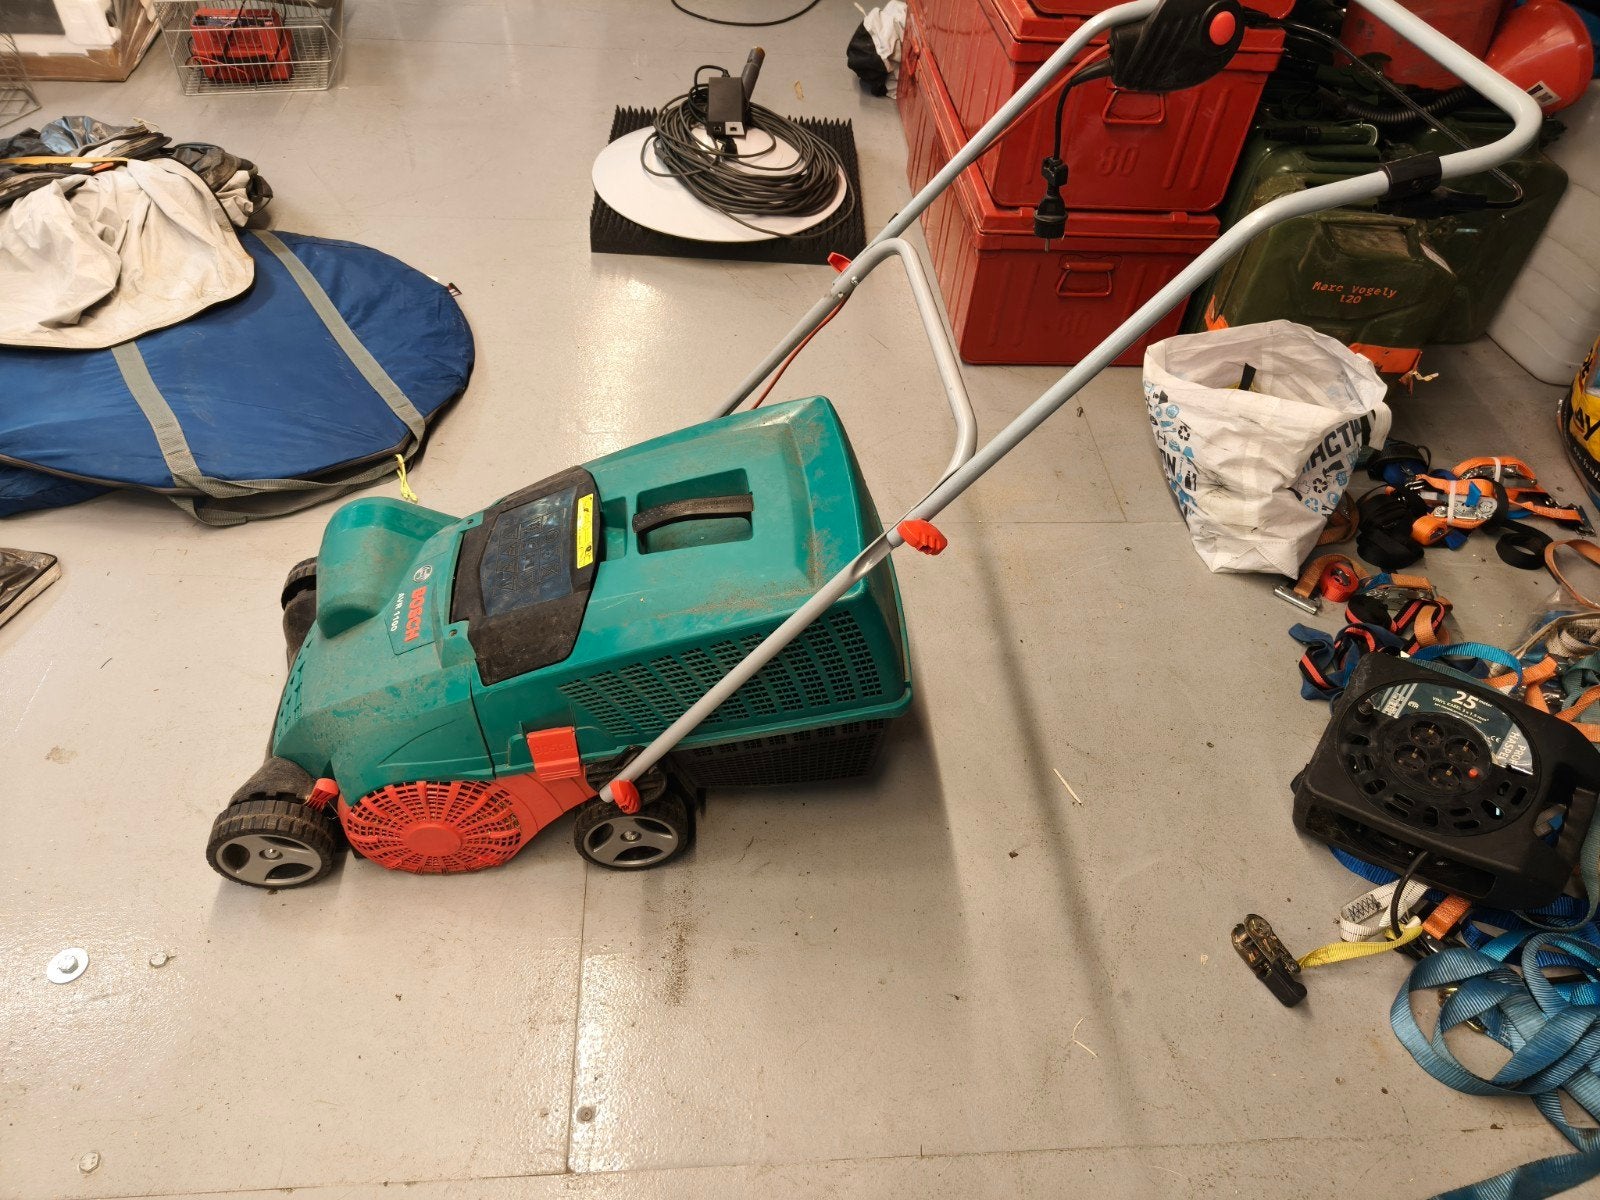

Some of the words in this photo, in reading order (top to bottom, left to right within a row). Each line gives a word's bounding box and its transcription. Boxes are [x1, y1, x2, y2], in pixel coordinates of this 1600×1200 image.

[1312, 281, 1344, 292] Marc
[395, 592, 405, 610] AVR
[404, 585, 428, 643] BOSCH
[1451, 690, 1479, 710] 25
[1496, 731, 1520, 760] HASPEL
